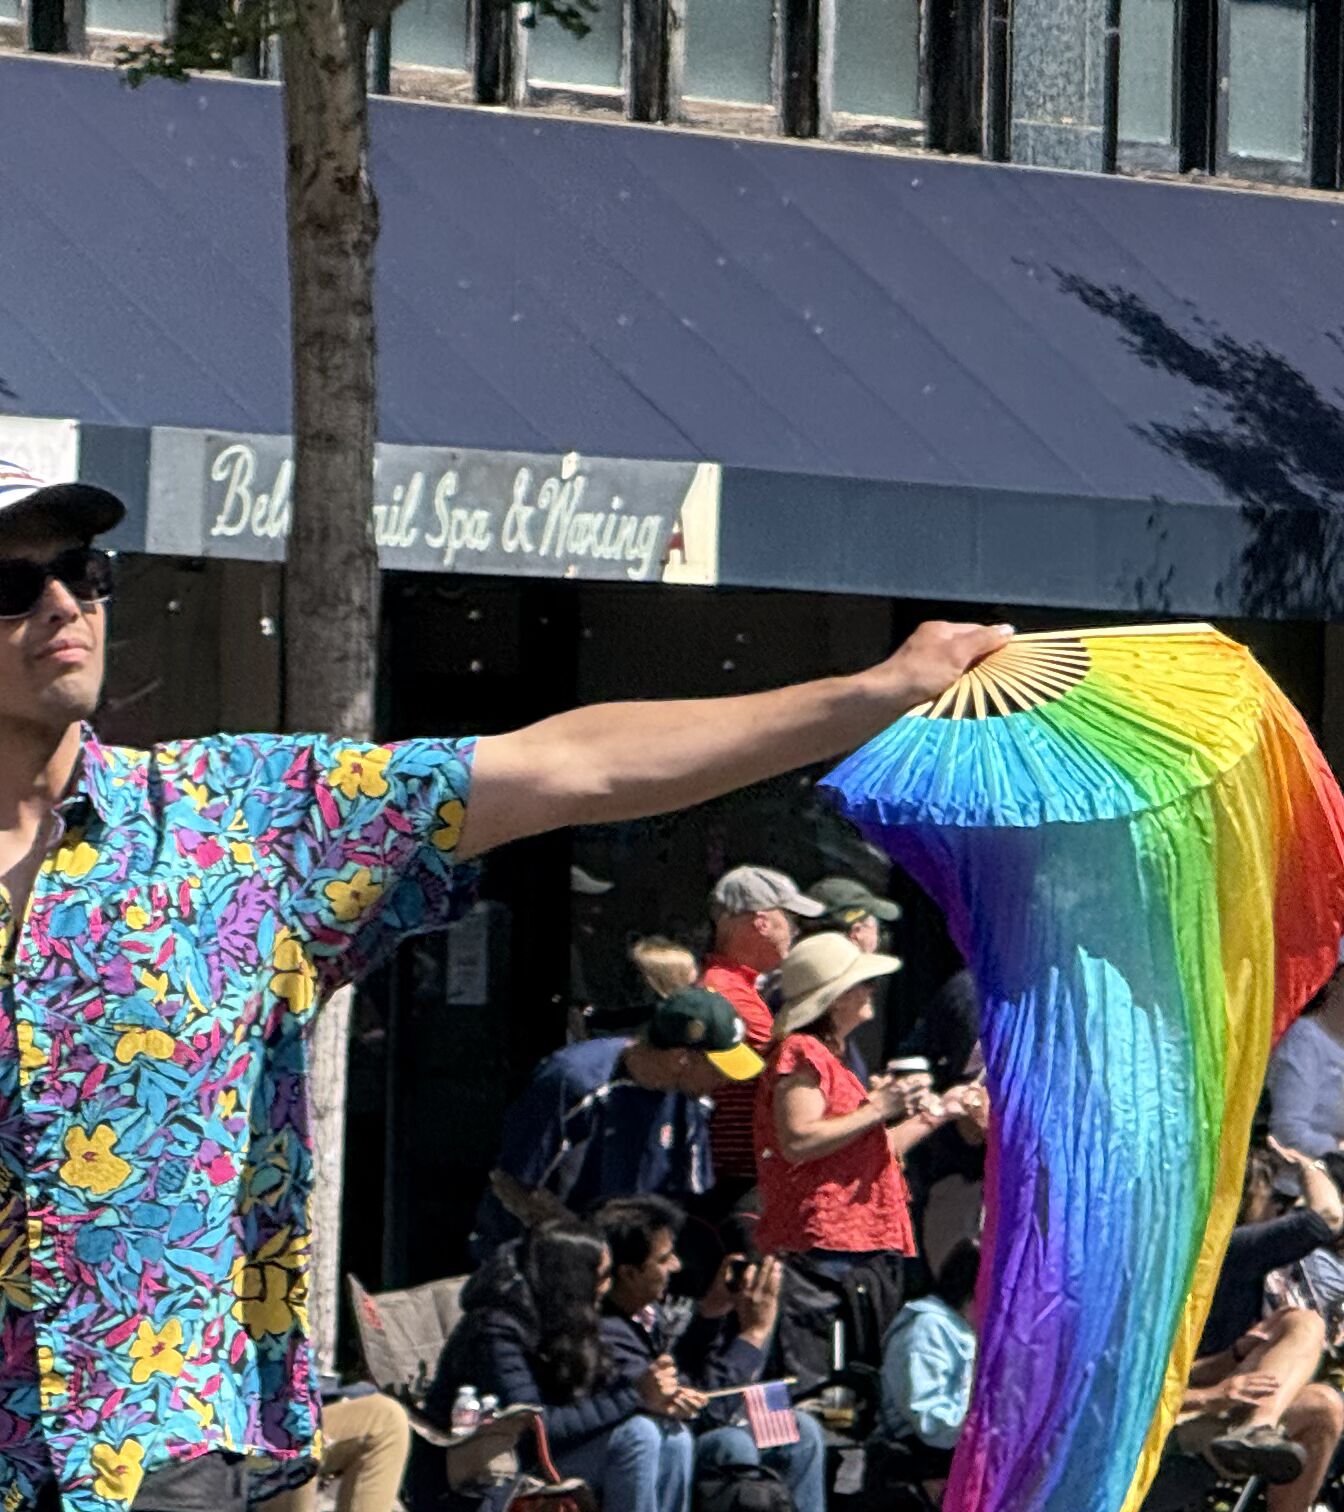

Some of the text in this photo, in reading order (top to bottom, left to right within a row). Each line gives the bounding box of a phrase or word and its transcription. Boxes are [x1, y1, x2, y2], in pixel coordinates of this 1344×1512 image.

[367, 458, 419, 548] ail
[424, 469, 494, 567] Spa
[502, 467, 538, 553] &
[538, 472, 663, 580] Waxing
